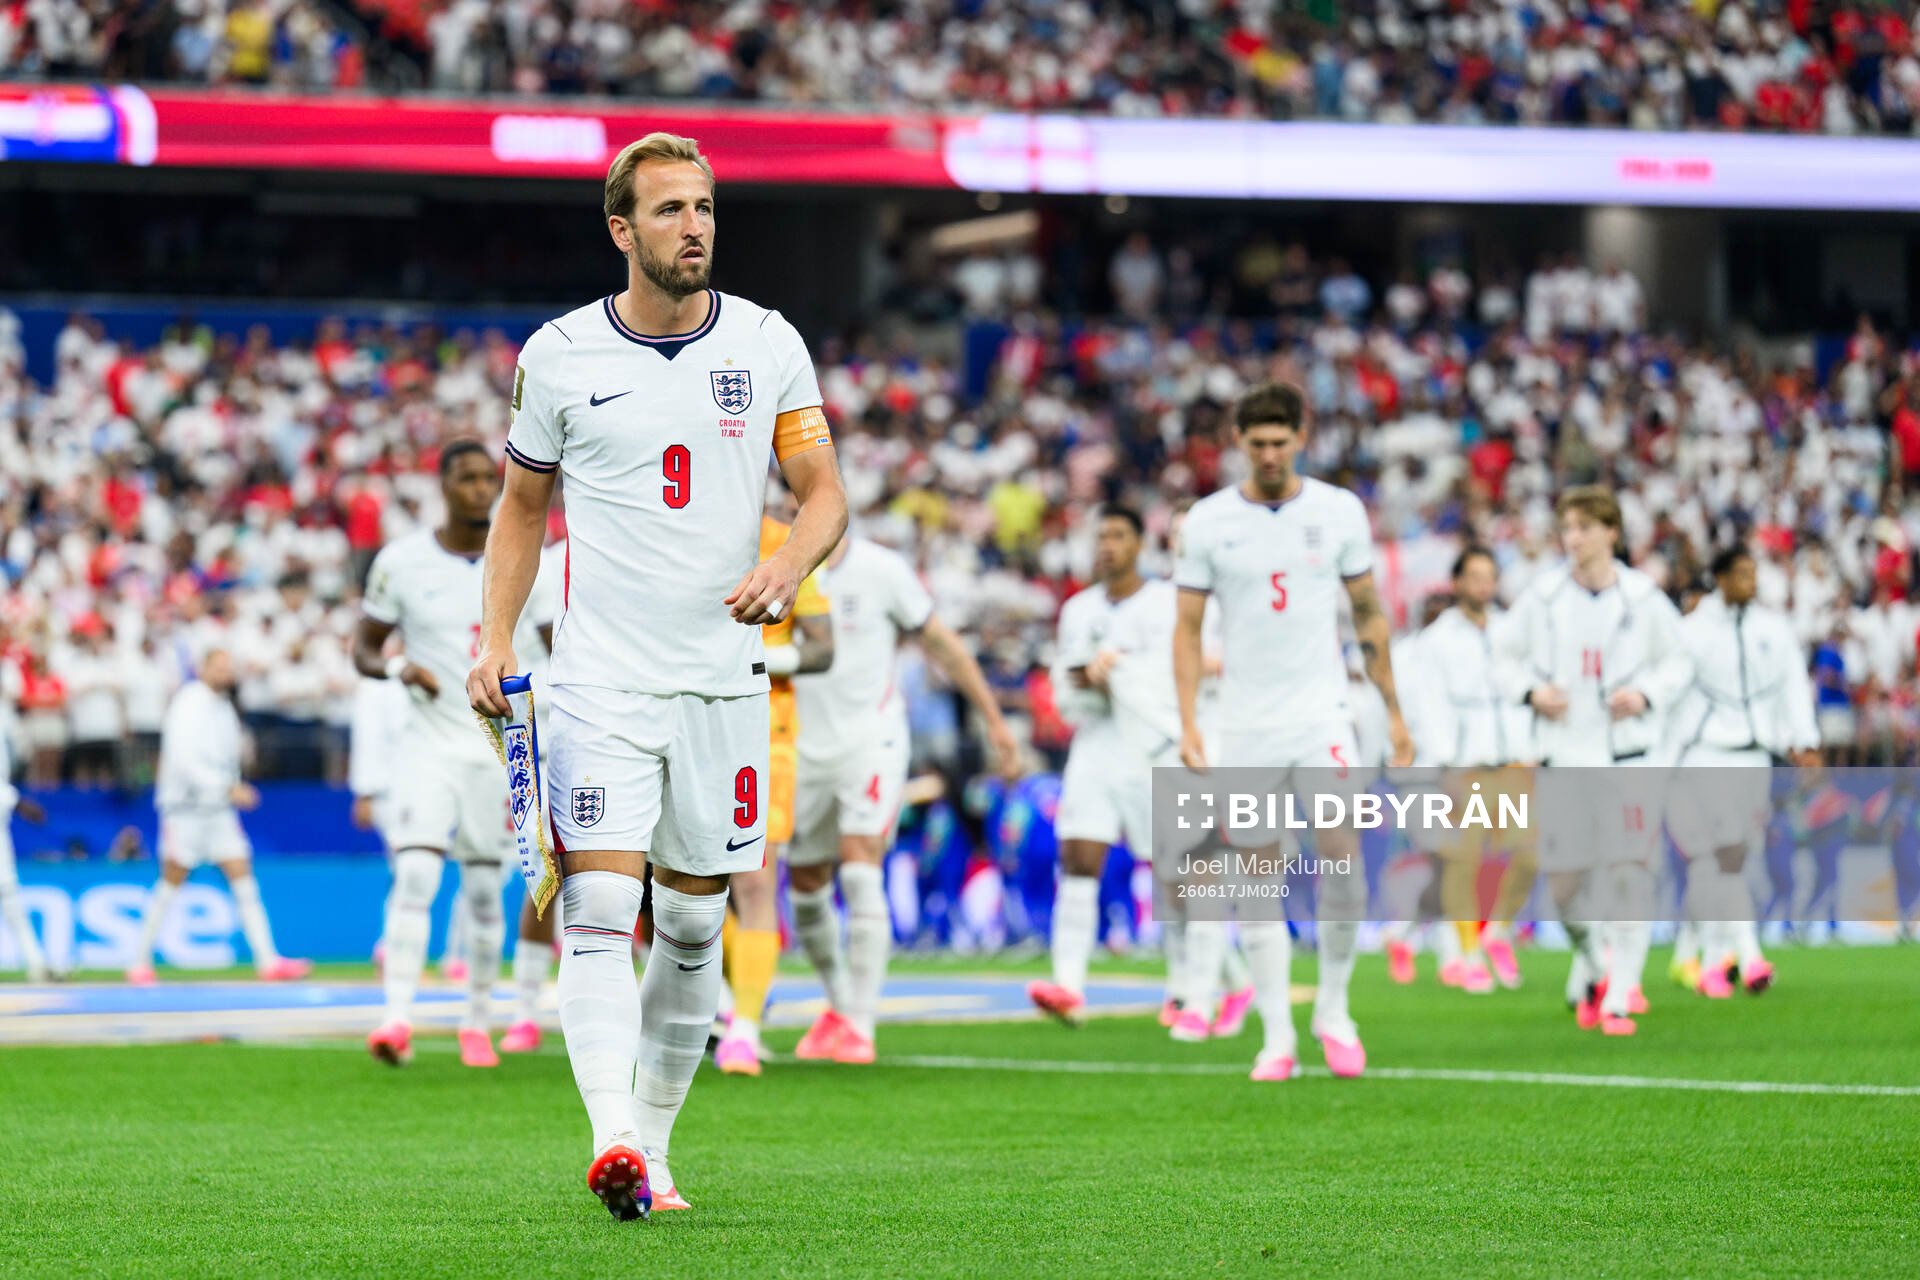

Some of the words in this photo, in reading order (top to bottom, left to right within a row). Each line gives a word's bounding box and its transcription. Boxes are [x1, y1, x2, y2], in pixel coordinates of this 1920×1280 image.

[719, 419, 746, 428] CROATIA
[663, 444, 691, 509] 9
[1271, 572, 1287, 612] 5
[1330, 745, 1349, 780] 5
[733, 765, 758, 829] 9
[865, 773, 880, 804] 4
